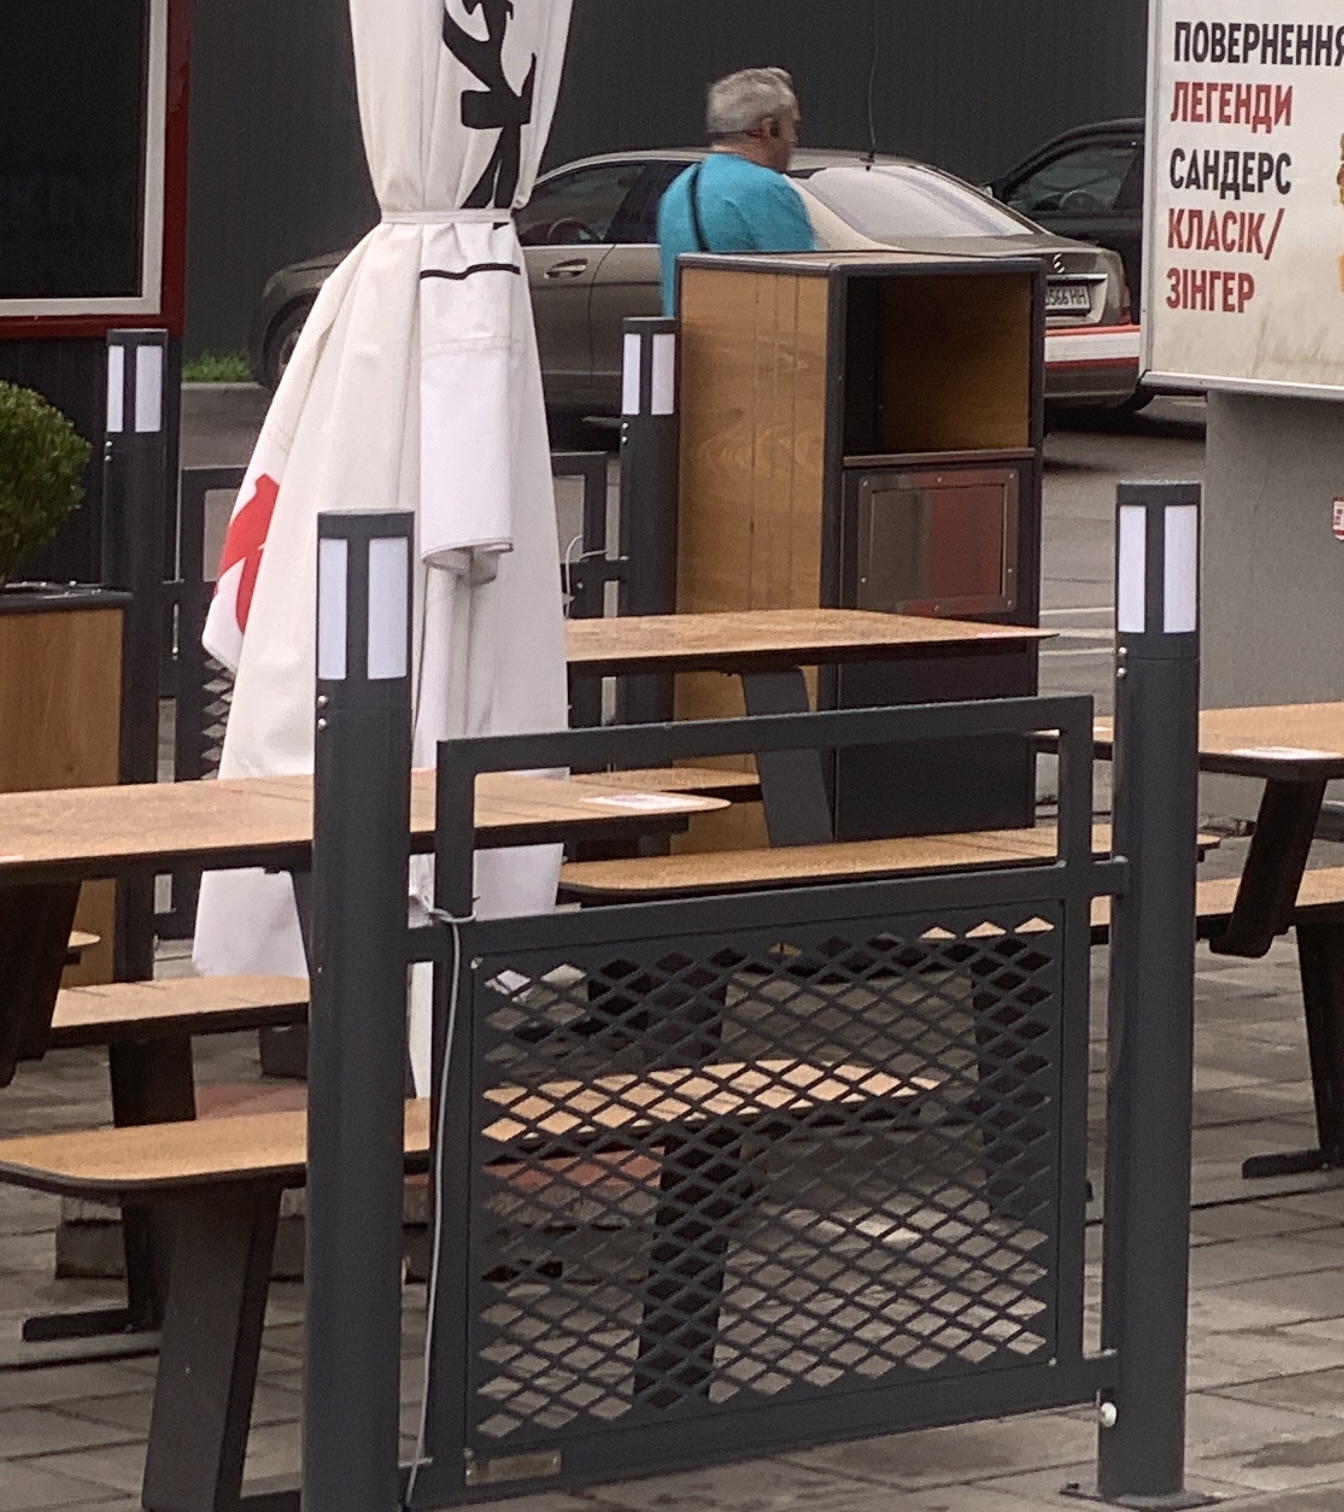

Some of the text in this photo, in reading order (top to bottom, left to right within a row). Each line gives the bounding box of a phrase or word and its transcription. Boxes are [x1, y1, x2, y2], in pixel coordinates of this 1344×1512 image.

[1171, 81, 1294, 134] ЛЕГЕНДИ
[1169, 148, 1293, 200] САНДЕРС
[1167, 207, 1284, 261] КЛАСІК/
[1166, 271, 1256, 315] ЗІНГЕР
